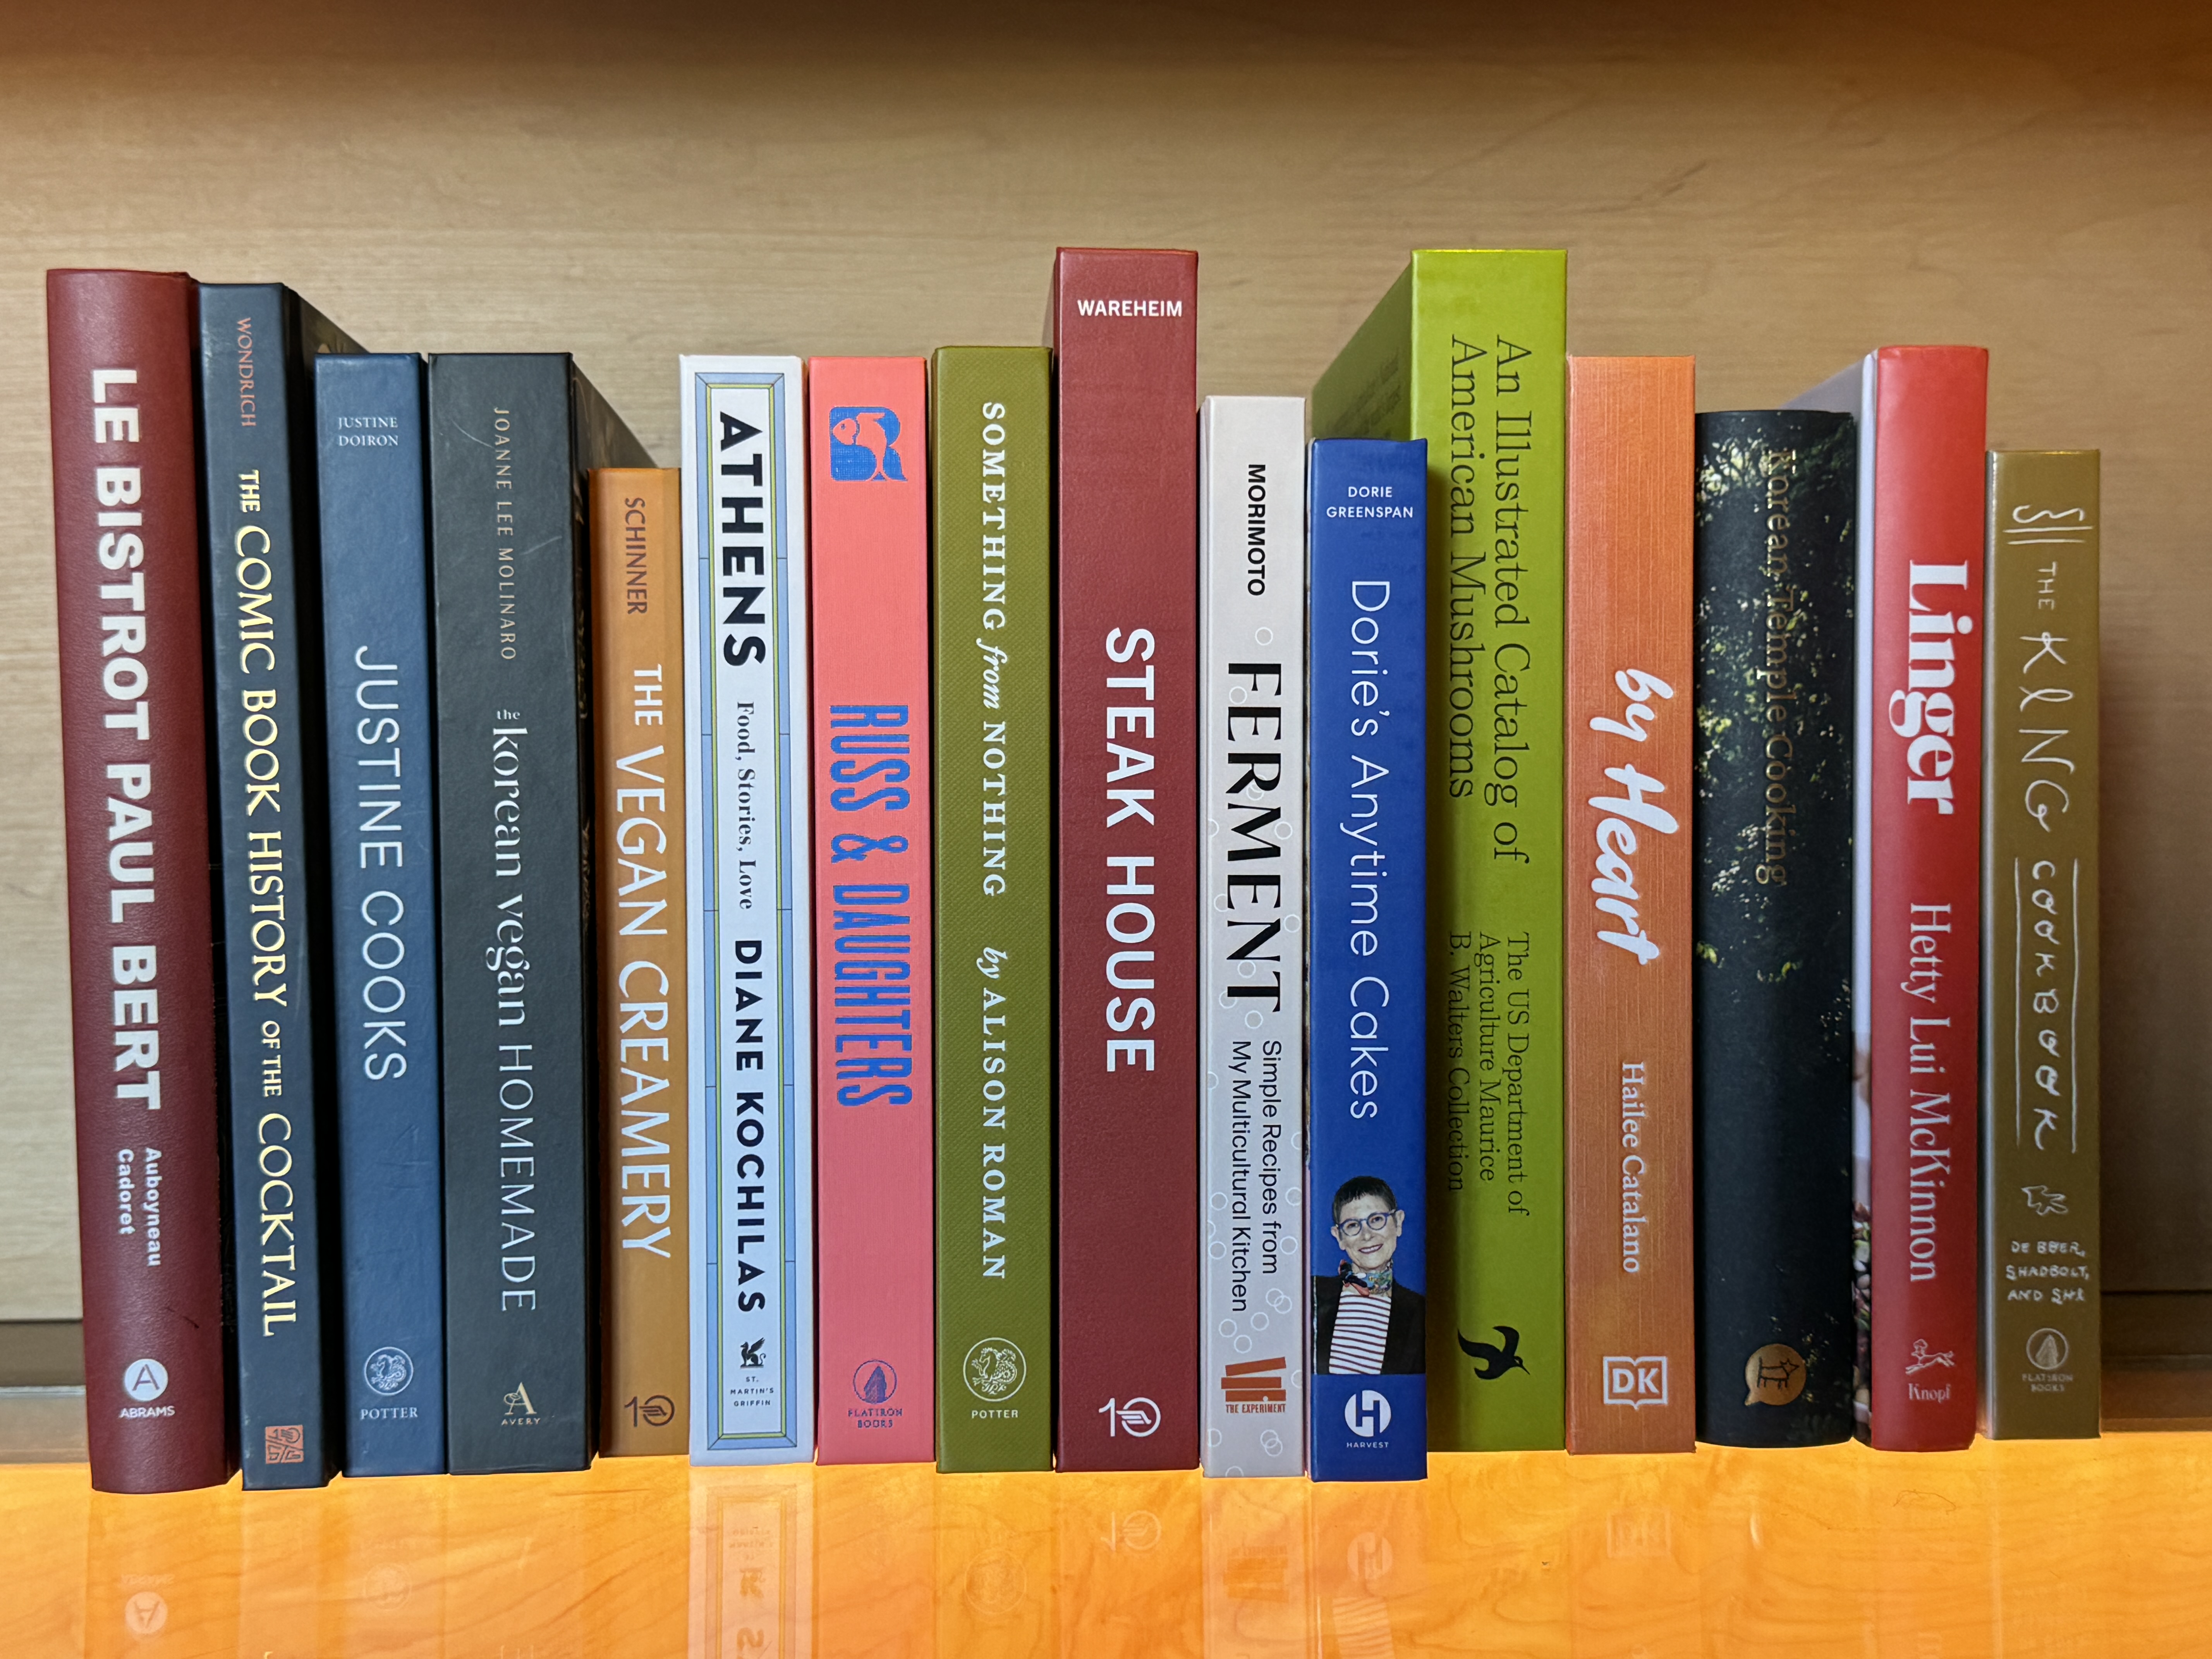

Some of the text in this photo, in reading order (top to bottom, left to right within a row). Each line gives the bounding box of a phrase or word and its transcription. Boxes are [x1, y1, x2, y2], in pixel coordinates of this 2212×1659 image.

[237, 317, 256, 427] WONDRICH
[1077, 299, 1182, 317] WAREHEIM
[338, 417, 398, 430] JUSTINE
[338, 434, 398, 447] DOIRON
[1326, 506, 1413, 518] GREENSPAN
[1348, 486, 1393, 498] DORIE
[493, 407, 517, 660] JOANNE LEE MOLINARO
[624, 497, 648, 615] SCHINNER
[720, 411, 766, 666] ATHENS
[1247, 464, 1266, 596] MORIMOTO
[1449, 334, 1488, 799] American Mushrooms
[1484, 334, 1532, 864] An Illustrated Catalog of
[92, 369, 161, 1110] LE BISTROT PAUL BERT
[496, 709, 520, 720] the
[1754, 448, 1797, 887] Korean Temple Cooking
[1888, 559, 1973, 814] Linger
[235, 469, 296, 1337] THE COMIC BOOK HISTORY OF THE COCKTAIL
[355, 645, 407, 1080] JUSTINE COOKS
[735, 702, 756, 909] Food, Stories, Love
[829, 704, 913, 1107] RUSS & DAUGHTERS
[975, 402, 1008, 1279] SOMETHING from NOTHING by ALISON ROMAN
[1105, 627, 1156, 1072] STEAK HOUSE
[1225, 663, 1282, 1013] FERMENT
[1340, 754, 1389, 956] Anytime
[1588, 668, 1680, 965] by Heart
[2018, 561, 2075, 1151] THE KING COOKBOOK
[486, 727, 536, 1312] korean vegan HOMEMADE
[615, 663, 671, 1259] THE VEGAN CREAMERY
[1350, 976, 1389, 1119] Cakes
[1446, 931, 1472, 1192] B. Walters Collection
[1473, 931, 1502, 1181] Agriculture Maurice
[735, 940, 766, 1312] DIANE KOCHILAS
[1258, 1040, 1282, 1274] Simple Recipes from
[1502, 931, 1530, 1216] The US Department of
[1621, 1061, 1647, 1274] Hailee Catalano
[1900, 902, 1951, 1282] Hetty Lui McKinnon
[118, 1148, 136, 1235] Cadoret
[143, 1147, 163, 1266] Auboyneau
[1228, 1041, 1252, 1312] My Multicultural Kitchen
[2005, 1264, 2090, 1280] SHADBOLT,
[2011, 1240, 2030, 1253] DE
[730, 1387, 774, 1395] MARTIN'S
[1611, 1368, 1660, 1393] DK
[1907, 1381, 1952, 1404] Knopf
[2007, 1288, 2043, 1301] AND
[119, 1405, 175, 1419] ABRAMS
[360, 1407, 418, 1420] POTTER
[501, 1417, 541, 1425] AVERY
[848, 1407, 903, 1417] FLATIRON
[857, 1419, 893, 1429] BOOKS
[971, 1409, 1018, 1419] POTTER
[1225, 1403, 1286, 1413] THE EXPERIMENT
